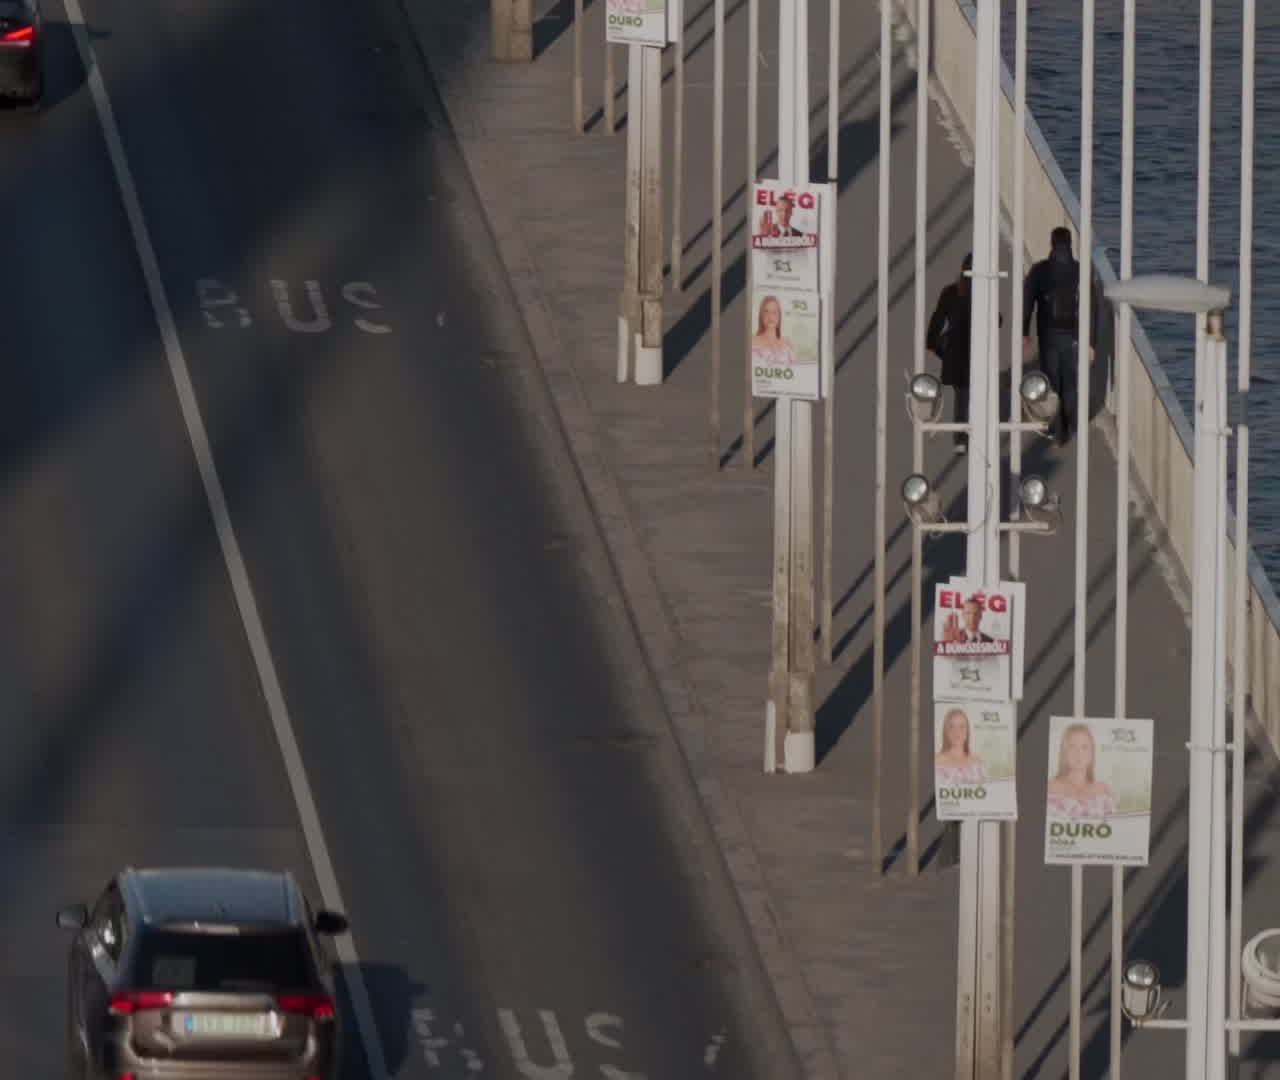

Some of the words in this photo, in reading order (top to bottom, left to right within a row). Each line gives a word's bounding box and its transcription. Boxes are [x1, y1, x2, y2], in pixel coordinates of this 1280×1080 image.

[608, 14, 643, 28] DURÓ
[755, 365, 794, 381] DURÓ
[939, 588, 1008, 613] ELÉG
[936, 643, 944, 654] A
[939, 783, 987, 800] DURÓ
[1049, 818, 1113, 839] DURÓ
